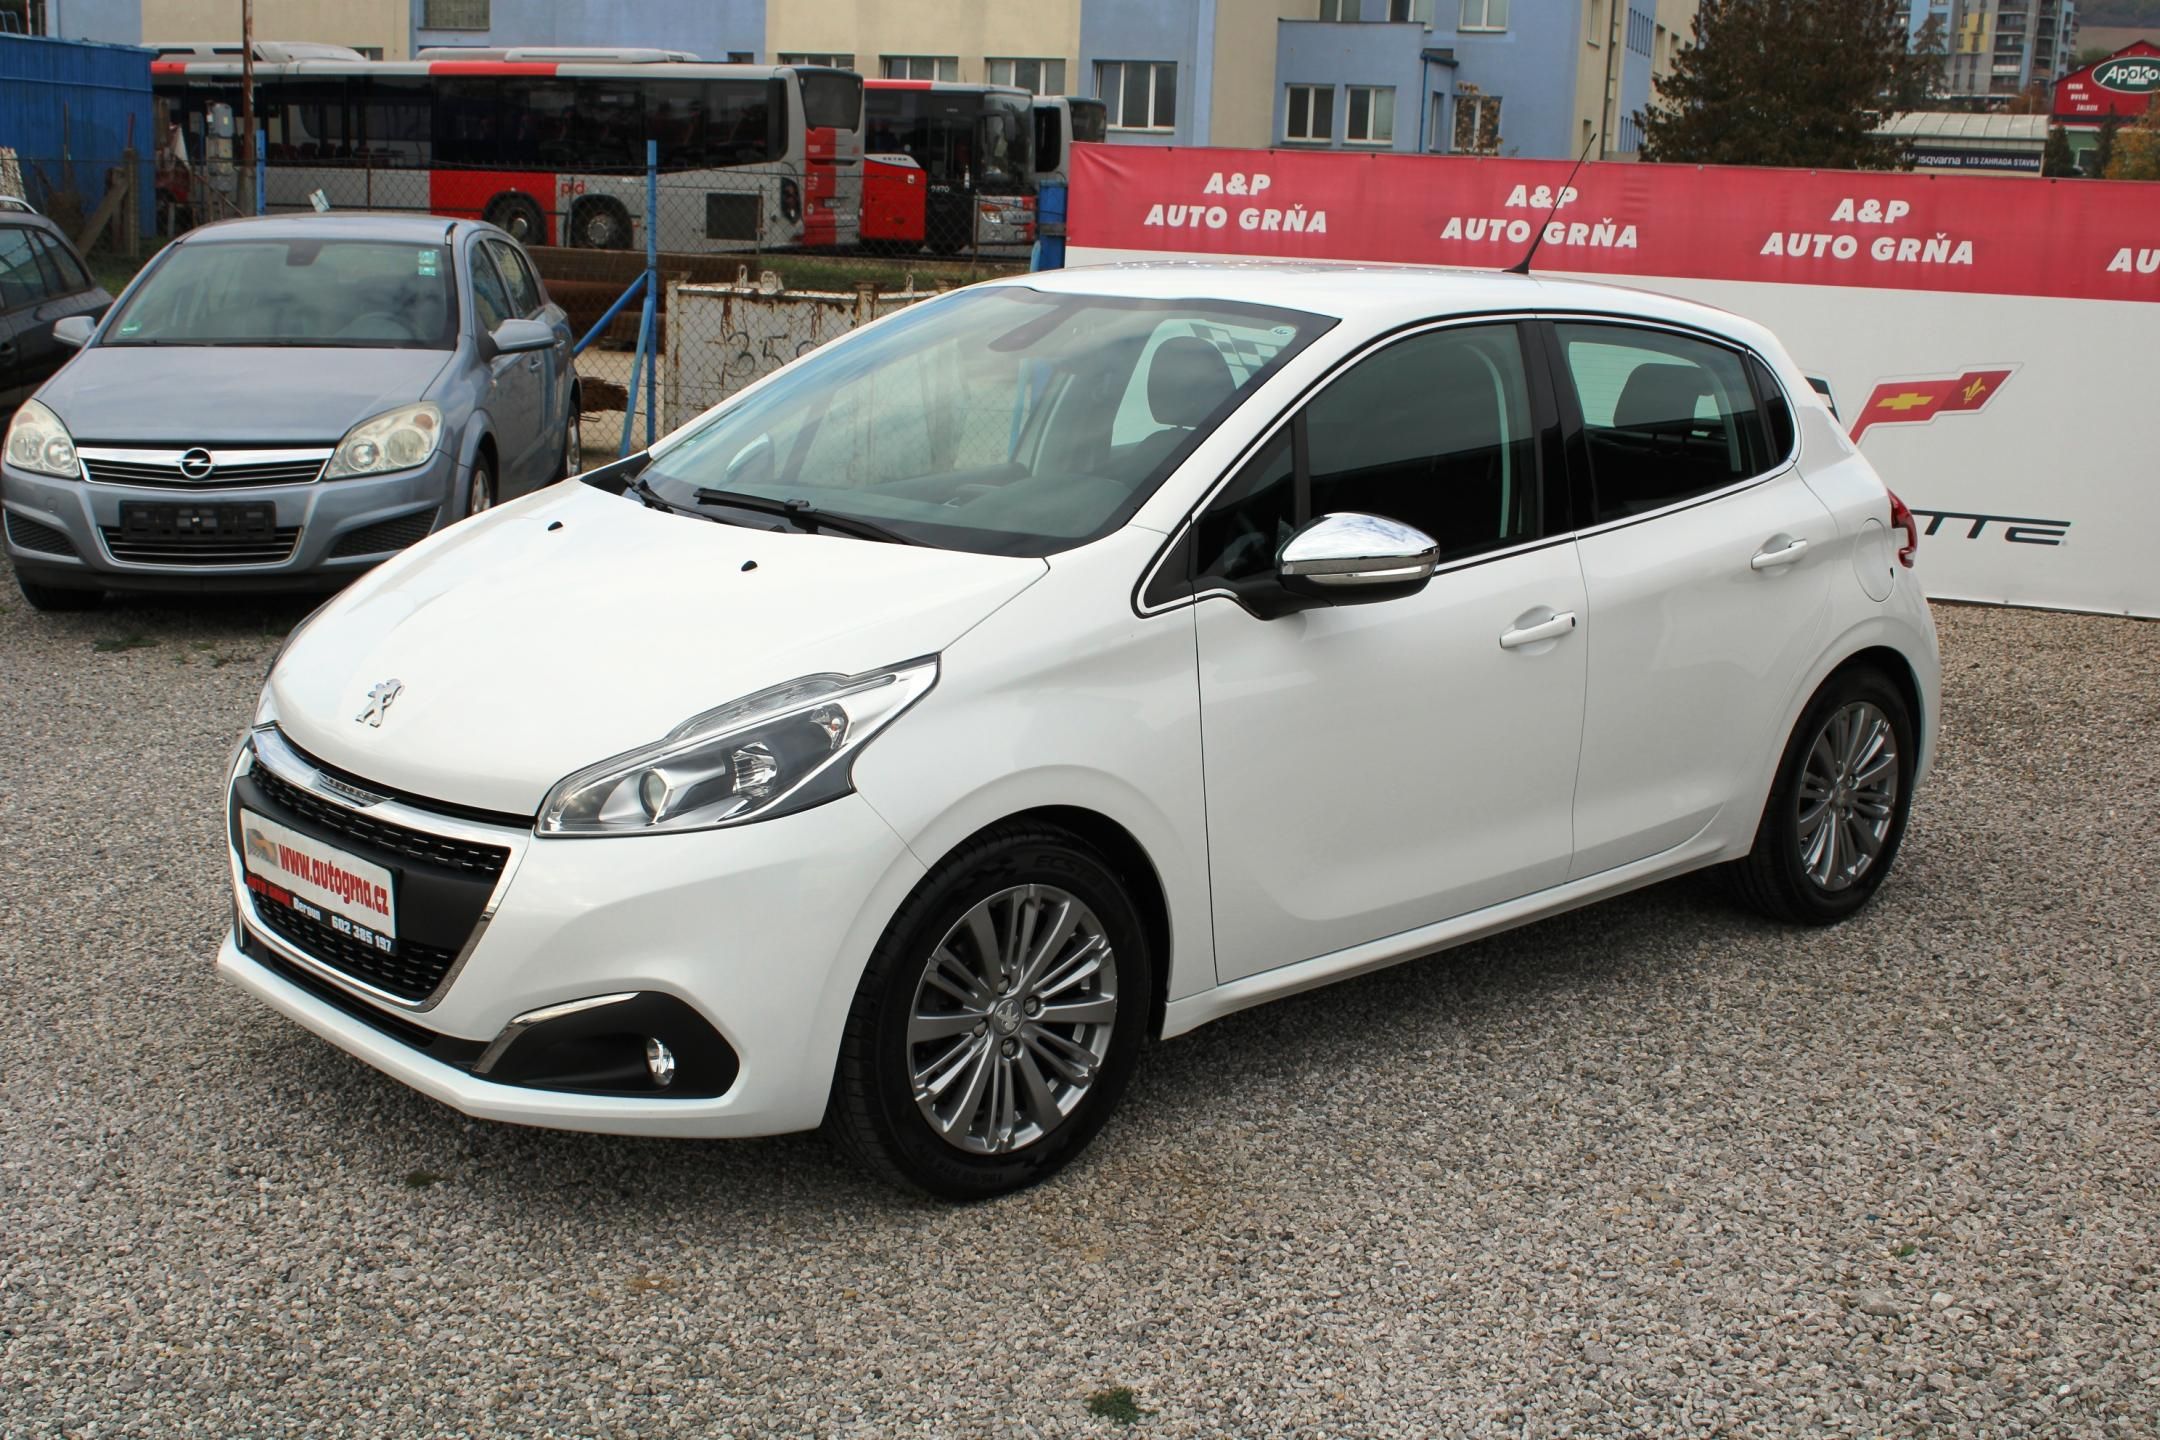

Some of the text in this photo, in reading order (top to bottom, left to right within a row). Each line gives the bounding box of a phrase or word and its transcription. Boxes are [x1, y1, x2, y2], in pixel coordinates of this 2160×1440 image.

[1966, 156, 1979, 164] LES
[561, 181, 585, 197] pd
[1203, 172, 1271, 195] A&P
[1505, 184, 1578, 208] A&P
[1144, 203, 1327, 233] AUTO GRŇA
[1831, 198, 1910, 223] A&P
[1440, 217, 1637, 248] AUTO GRŇA
[1760, 232, 1974, 265] AUTO GRŇA
[278, 843, 389, 916] www.autogrna.cz
[331, 915, 352, 935] 602
[375, 935, 391, 952] 197
